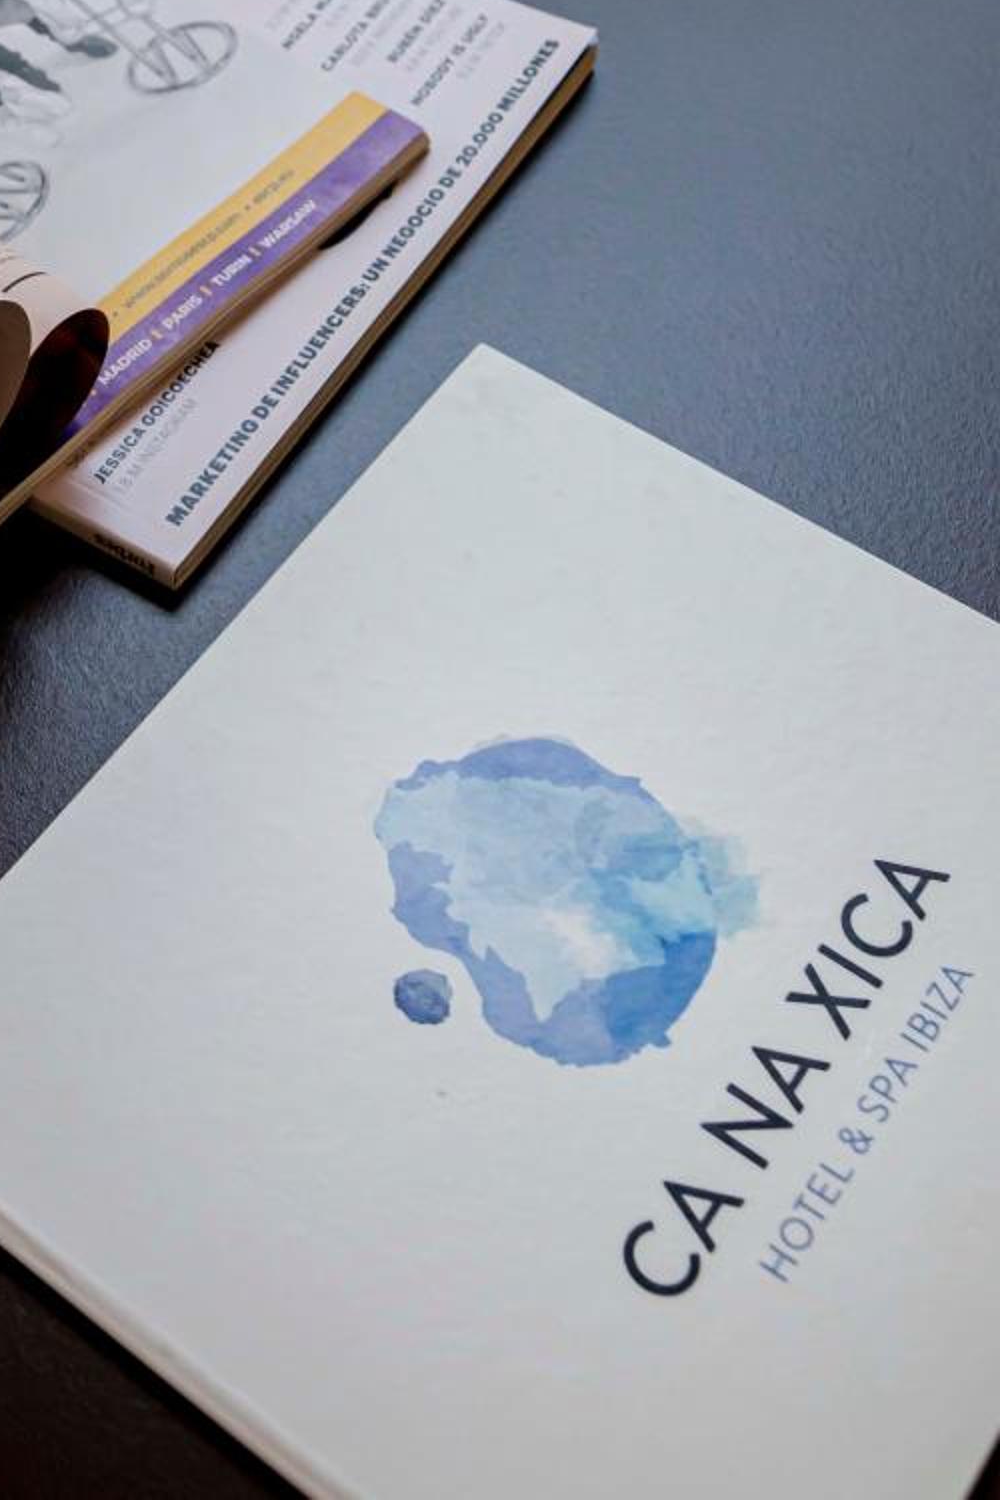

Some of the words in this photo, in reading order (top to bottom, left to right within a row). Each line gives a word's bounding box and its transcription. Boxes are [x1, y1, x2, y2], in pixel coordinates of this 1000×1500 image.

[96, 338, 153, 385] MADRID
[161, 293, 204, 331] PARIS
[210, 252, 253, 288] TURIN
[164, 414, 258, 527] MARKETING
[253, 385, 279, 422] DE
[270, 278, 372, 401] INFLUENCERS:
[363, 253, 390, 287] UN
[381, 181, 447, 263] NEGOCIO
[439, 157, 462, 190] DE
[454, 111, 505, 171] 20.000
[495, 36, 561, 118] MILLONES
[93, 422, 147, 484] JESSICA
[143, 340, 221, 427] GOICOECHEA
[901, 964, 975, 1053] IBIZA
[623, 1180, 745, 1298] CA
[700, 1046, 831, 1170] NA
[785, 859, 951, 1041] XICA
[839, 1126, 874, 1156] &
[856, 1057, 919, 1124] SPA
[759, 1161, 856, 1284] HOTEL
